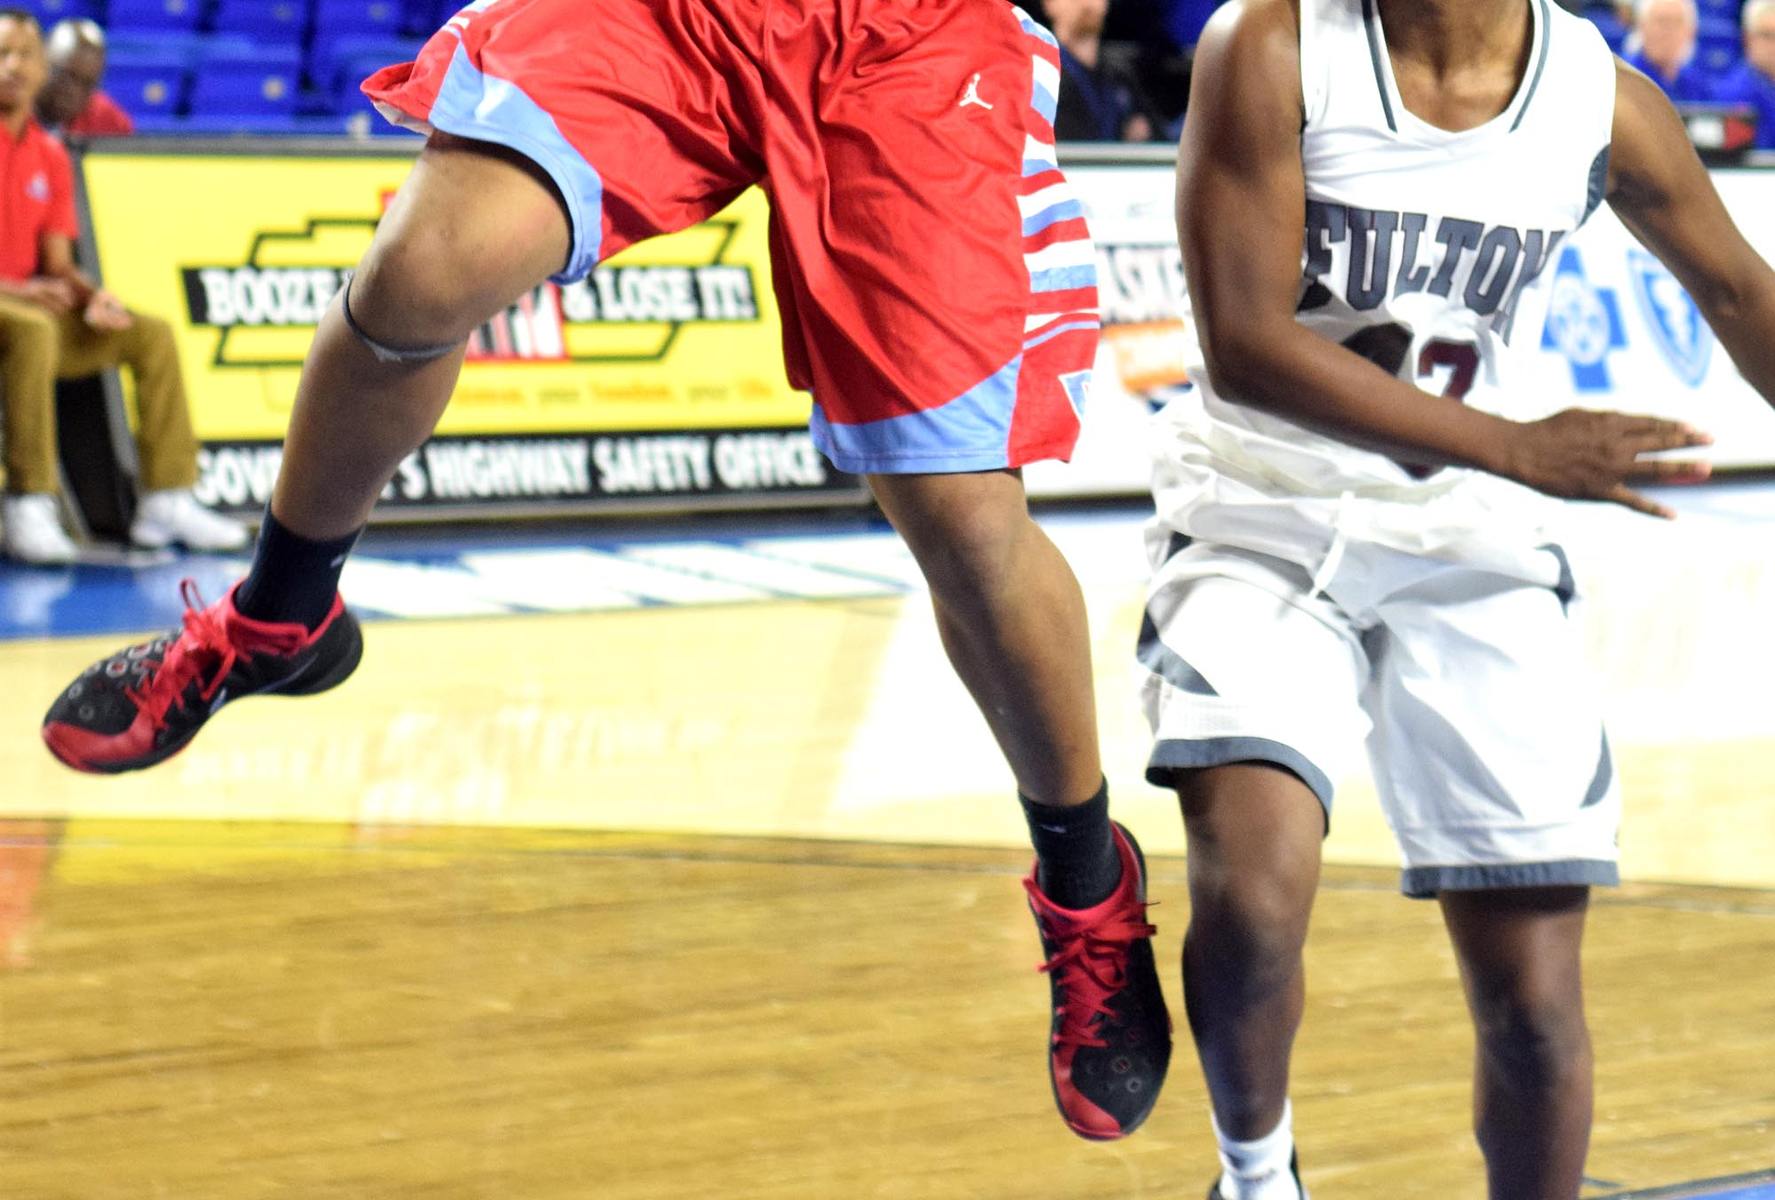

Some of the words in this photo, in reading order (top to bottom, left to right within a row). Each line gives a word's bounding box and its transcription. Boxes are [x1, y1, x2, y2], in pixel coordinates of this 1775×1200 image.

[200, 267, 338, 324] BOOZE
[597, 266, 697, 321] LOSE
[697, 266, 756, 319] IT!
[1303, 199, 1567, 349] FULTON
[424, 439, 590, 499] HIGHWAY
[592, 435, 711, 493] SAFETY
[713, 430, 827, 489] OFFICE
